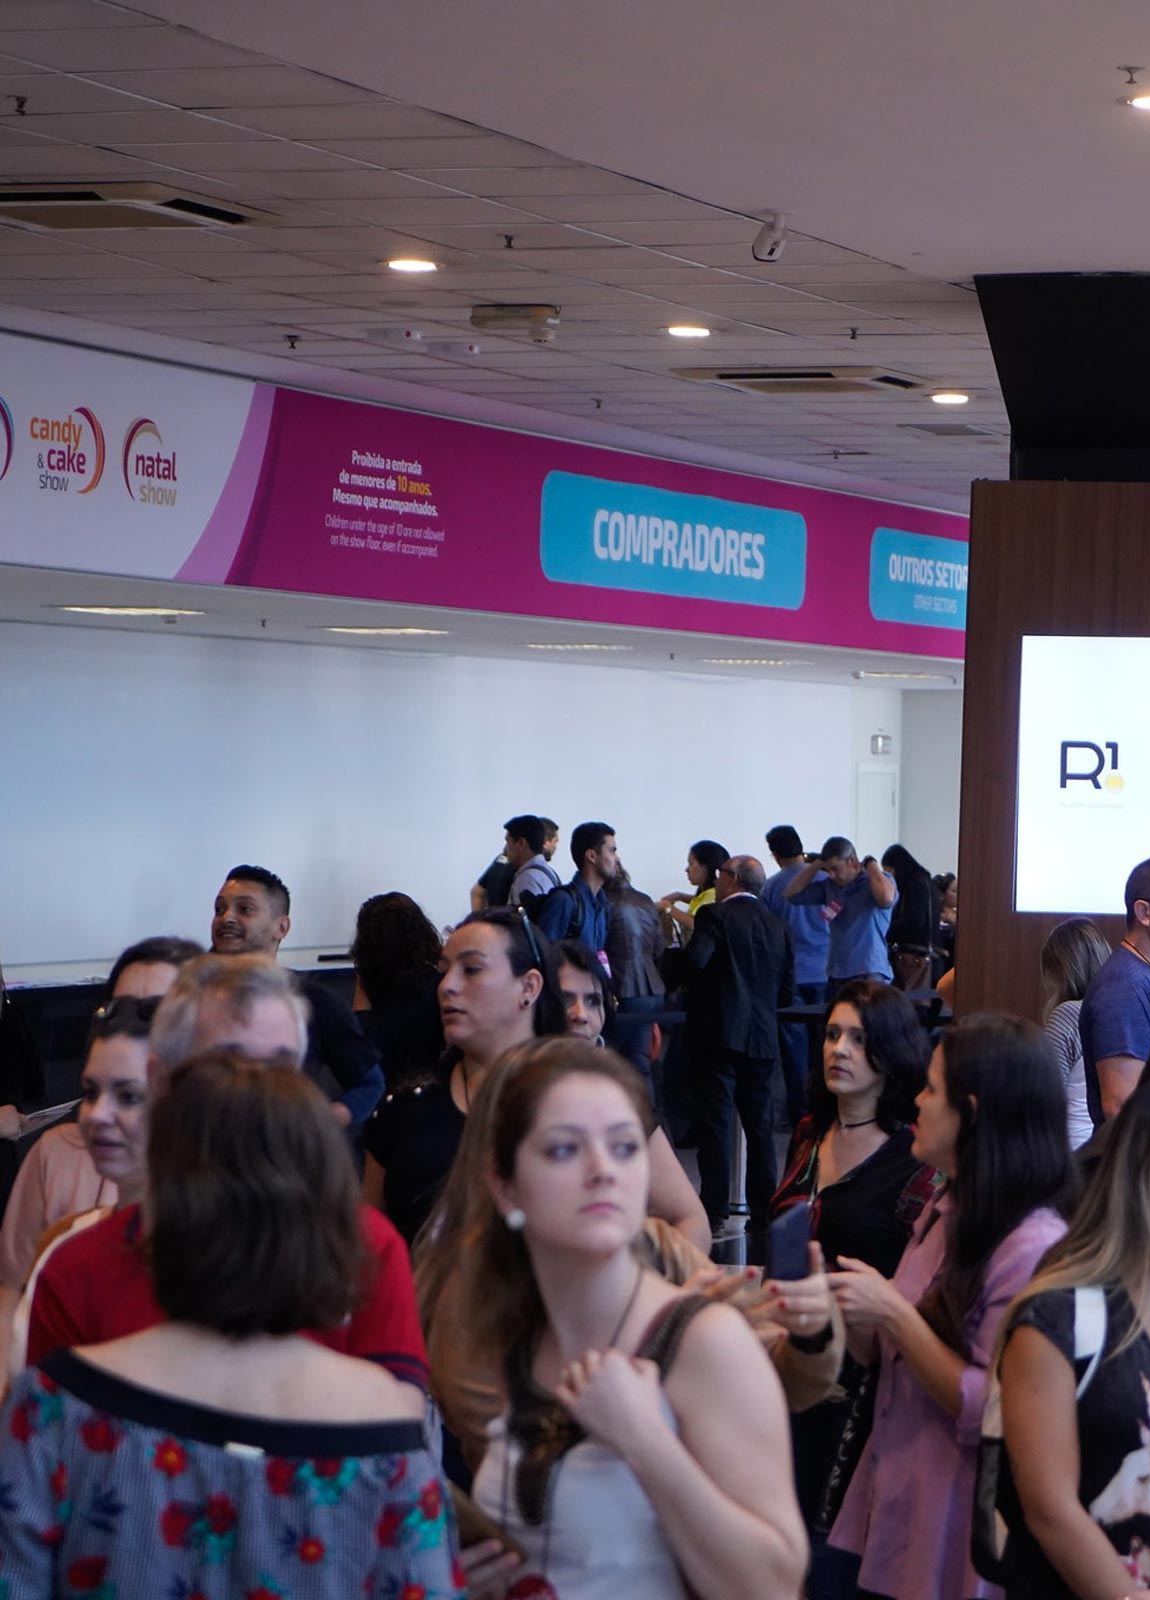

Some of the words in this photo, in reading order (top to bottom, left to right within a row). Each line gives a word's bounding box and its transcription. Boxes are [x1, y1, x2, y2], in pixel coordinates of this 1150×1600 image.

[30, 415, 82, 451] candy
[37, 453, 44, 469] &
[47, 445, 86, 474] cake
[135, 452, 177, 481] natal
[351, 449, 384, 469] Proibida
[386, 459, 391, 470] a
[391, 459, 422, 475] entrada
[39, 470, 69, 492] show
[140, 479, 177, 507] show
[339, 469, 350, 484] de
[350, 473, 385, 490] menores
[386, 475, 396, 491] de
[397, 475, 407, 492] 10
[332, 488, 363, 506] Mesmo
[363, 495, 378, 510] que
[593, 508, 766, 580] COMPRADORES
[889, 553, 934, 587] OUTROS
